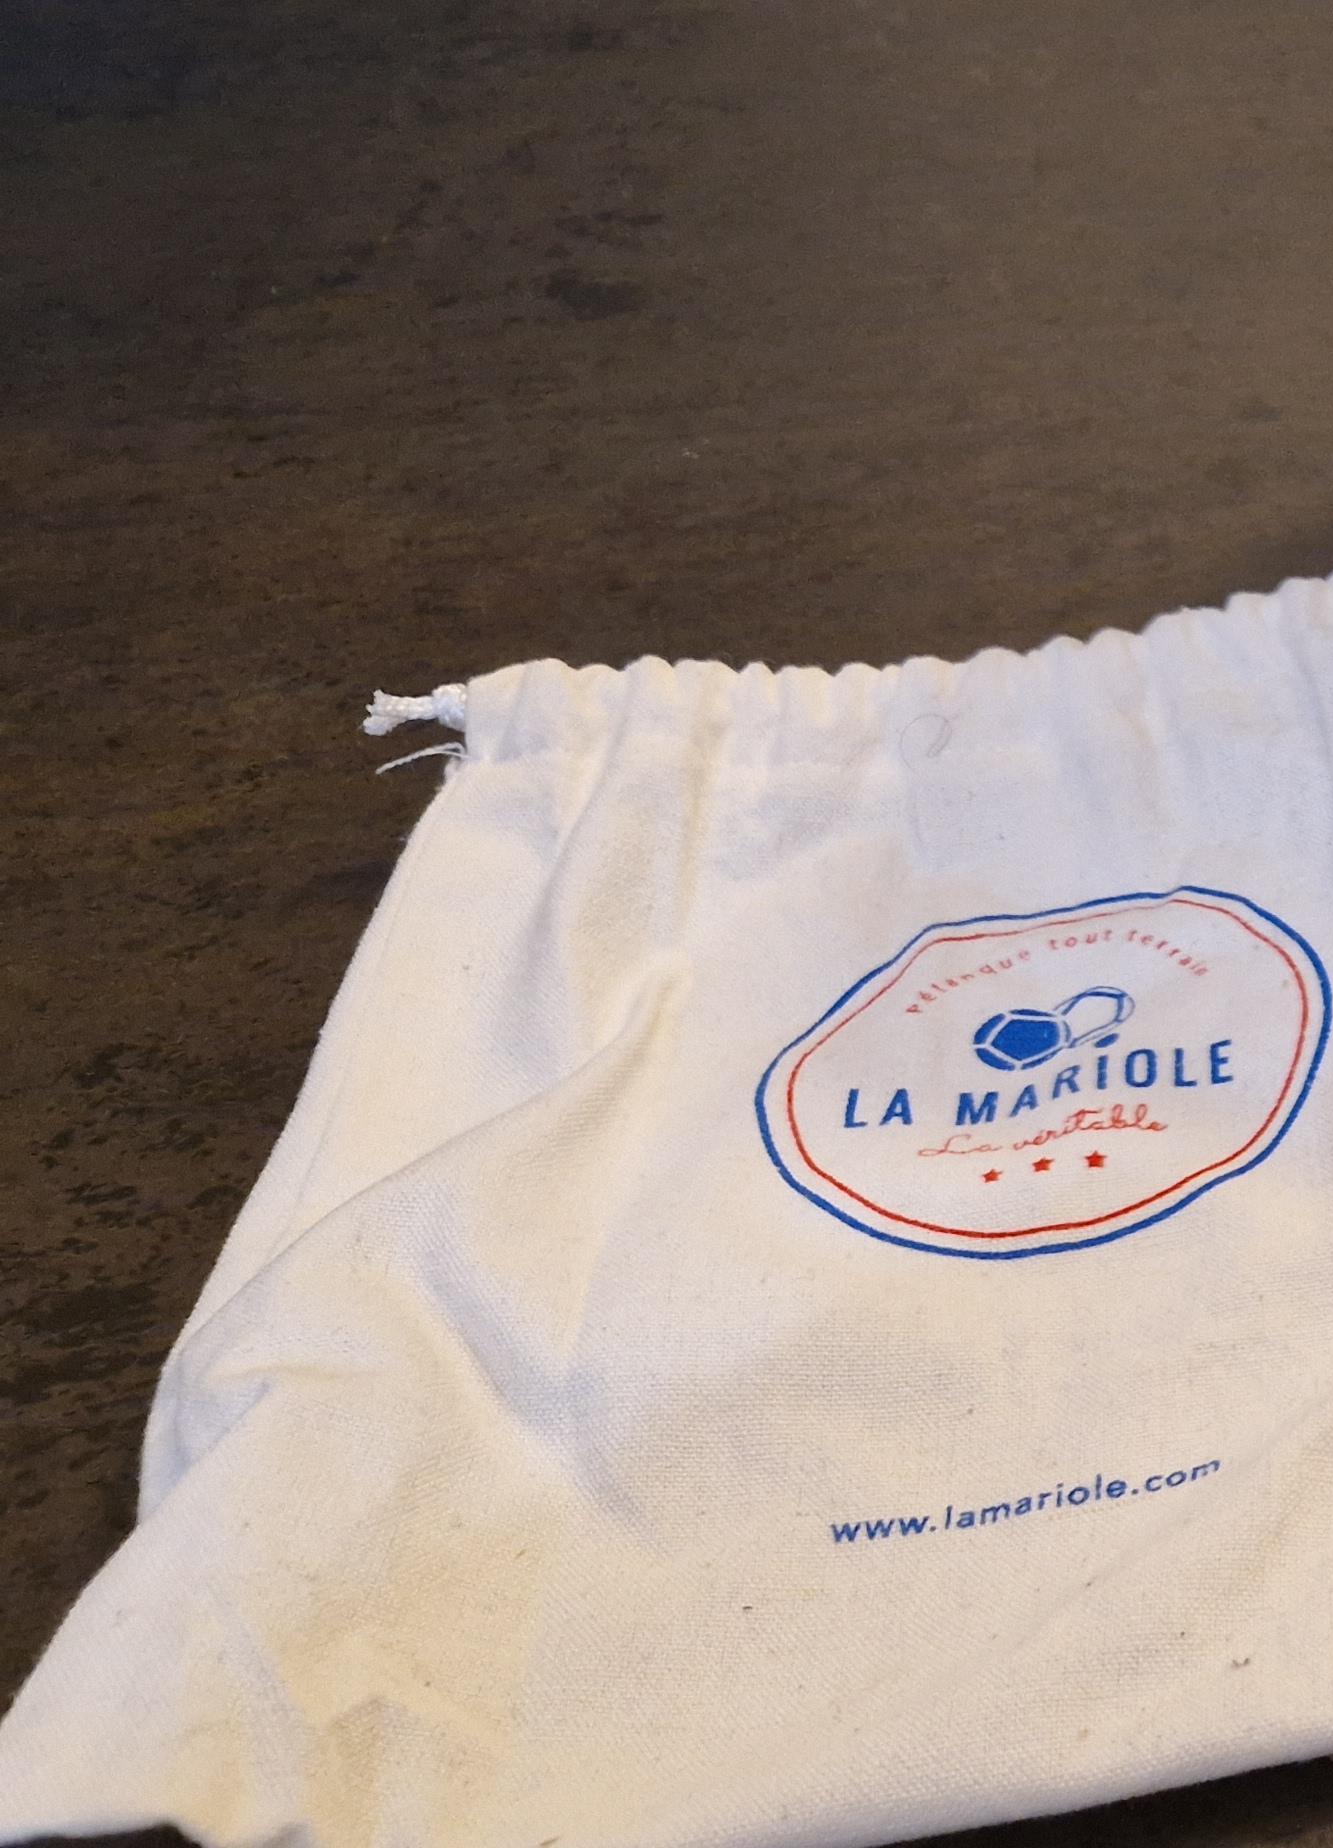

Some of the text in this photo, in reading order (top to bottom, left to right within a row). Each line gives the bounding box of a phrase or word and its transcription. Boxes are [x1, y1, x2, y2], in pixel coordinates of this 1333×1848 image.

[906, 928, 1209, 1014] Pétanque tout terrain
[842, 1039, 1234, 1129] LA MARIOLE
[917, 1103, 1169, 1157] La véritable
[830, 1459, 1222, 1544] www.lamariole.com
